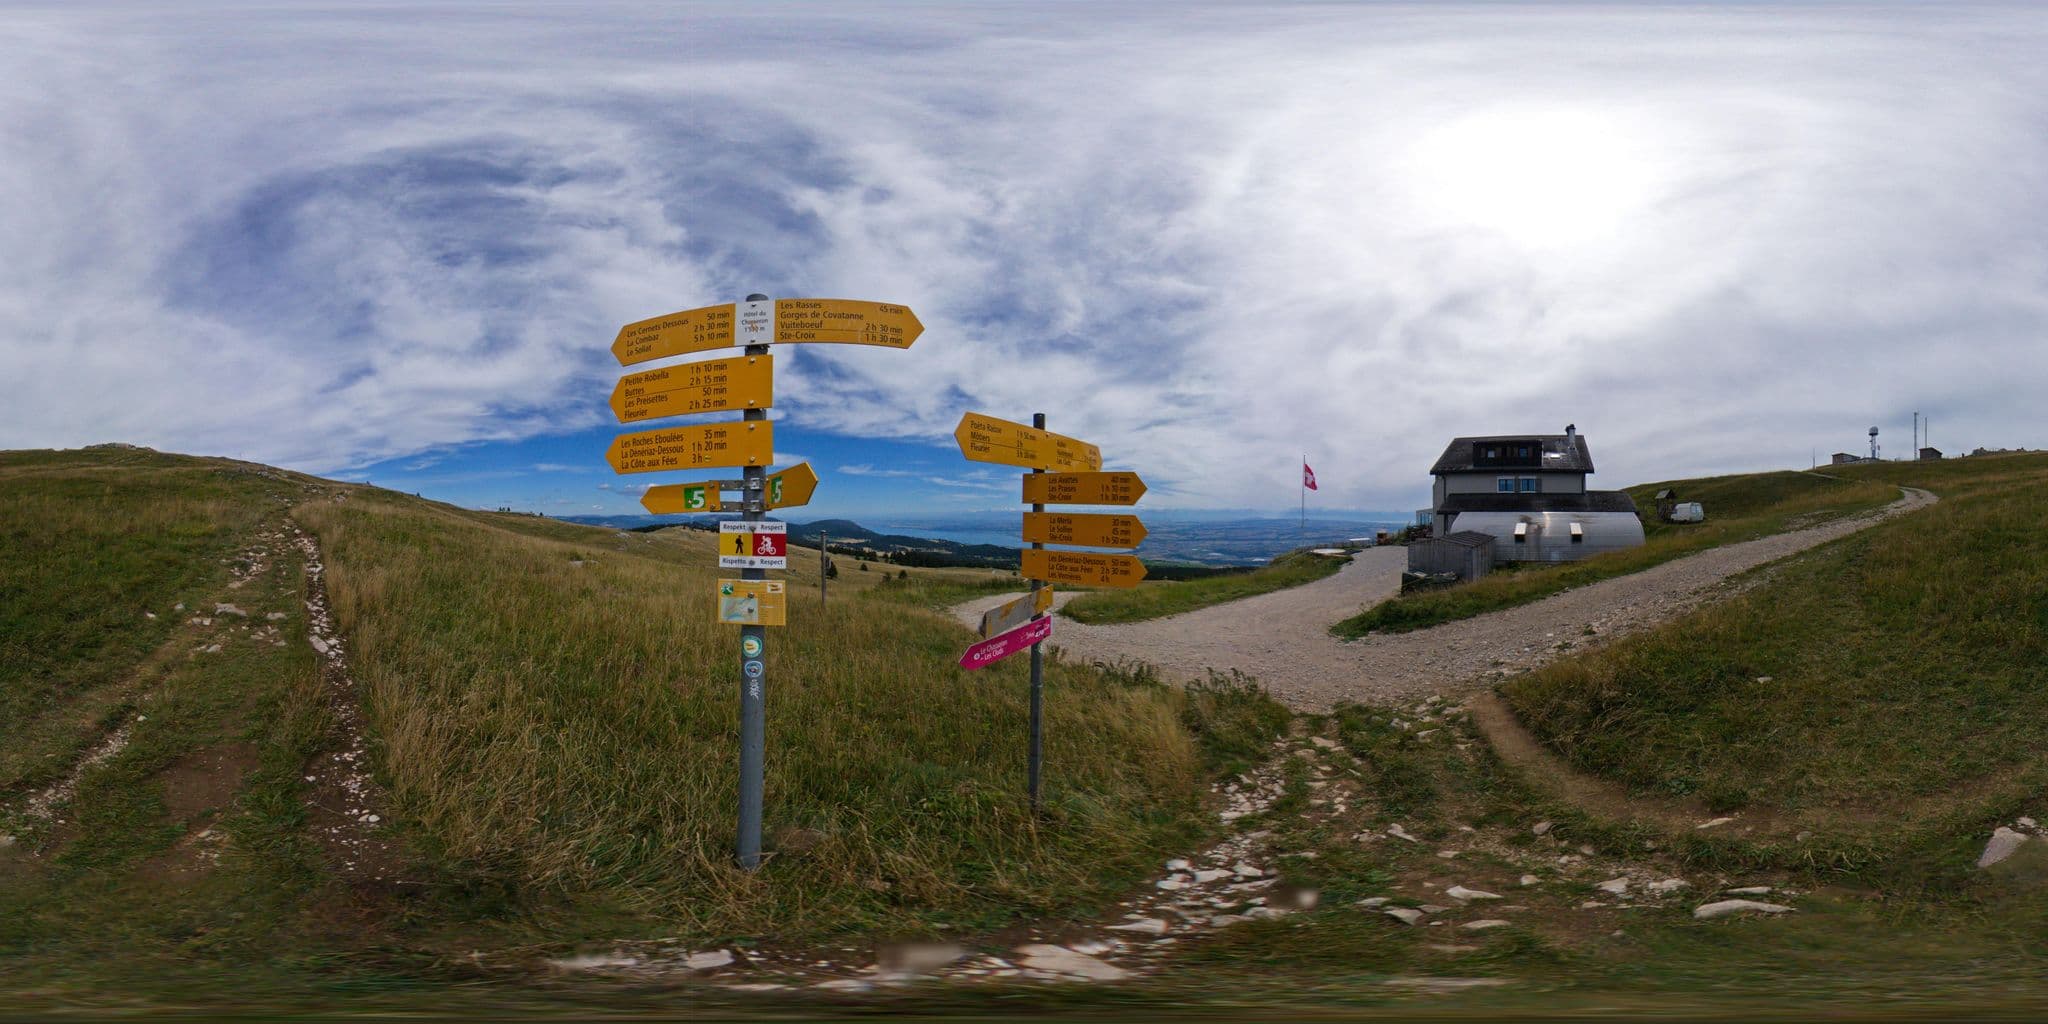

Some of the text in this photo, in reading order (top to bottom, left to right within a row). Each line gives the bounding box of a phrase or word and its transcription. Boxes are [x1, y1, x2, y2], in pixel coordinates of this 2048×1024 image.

[890, 306, 903, 314] min
[707, 312, 730, 321] 50 min
[780, 311, 810, 321] Gorges
[823, 311, 864, 320] Covatanne
[627, 330, 636, 338] Les
[663, 318, 689, 329] Dessous
[707, 322, 715, 330] 30
[716, 321, 730, 329] min
[780, 320, 823, 329] Vuiteboeuf
[871, 323, 876, 331] h
[879, 325, 888, 333] 30
[890, 326, 903, 334] min
[707, 333, 715, 341] 10
[780, 332, 816, 340] Ste-Croix
[871, 333, 876, 342] h
[879, 335, 888, 343] 30
[890, 336, 903, 344] min
[627, 349, 634, 357] Le
[696, 365, 701, 373] h
[704, 364, 712, 372] 10
[714, 362, 727, 371] min
[625, 372, 669, 386] Petite Robella
[695, 377, 701, 385] h
[714, 374, 727, 382] min
[703, 386, 727, 396] 50 min
[624, 400, 635, 409] Les
[695, 401, 700, 409] h
[703, 400, 711, 408] 25
[713, 398, 727, 407] min
[624, 409, 648, 419] Fleurier
[704, 428, 727, 439] 35 min
[621, 440, 631, 449] Les
[632, 437, 653, 447] Roches
[698, 442, 702, 450] h
[704, 441, 712, 451] 20
[714, 440, 727, 449] min
[621, 451, 628, 459] La
[692, 454, 702, 463] 3 h
[621, 455, 678, 469] La Côte aux Fées
[774, 480, 782, 503] 5
[691, 489, 704, 508] 5
[1048, 554, 1057, 562] Les
